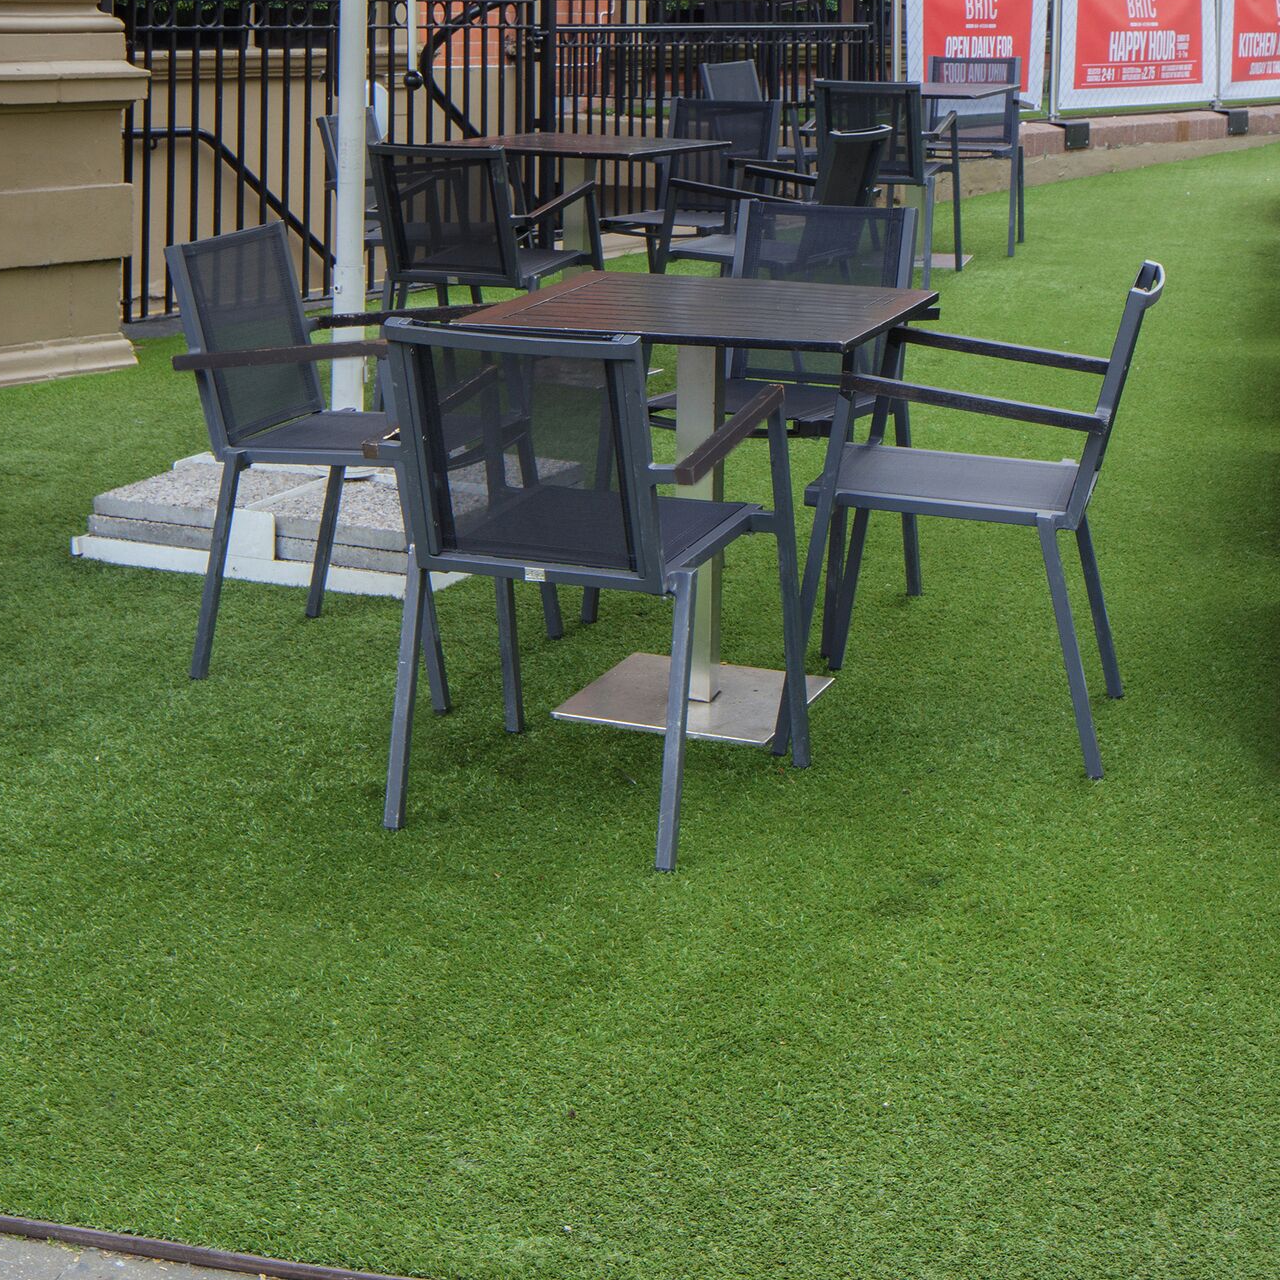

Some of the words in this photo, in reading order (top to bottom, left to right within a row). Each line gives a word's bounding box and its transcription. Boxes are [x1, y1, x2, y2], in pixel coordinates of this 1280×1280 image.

[945, 36, 969, 58] OPEN
[971, 36, 995, 58] DAILY
[996, 35, 1013, 57] FOR
[1109, 31, 1147, 62] HAPPY
[1148, 30, 1176, 60] HOUR
[1238, 32, 1277, 58] KITCHEN
[943, 62, 966, 84] FOOD
[968, 62, 986, 83] AND
